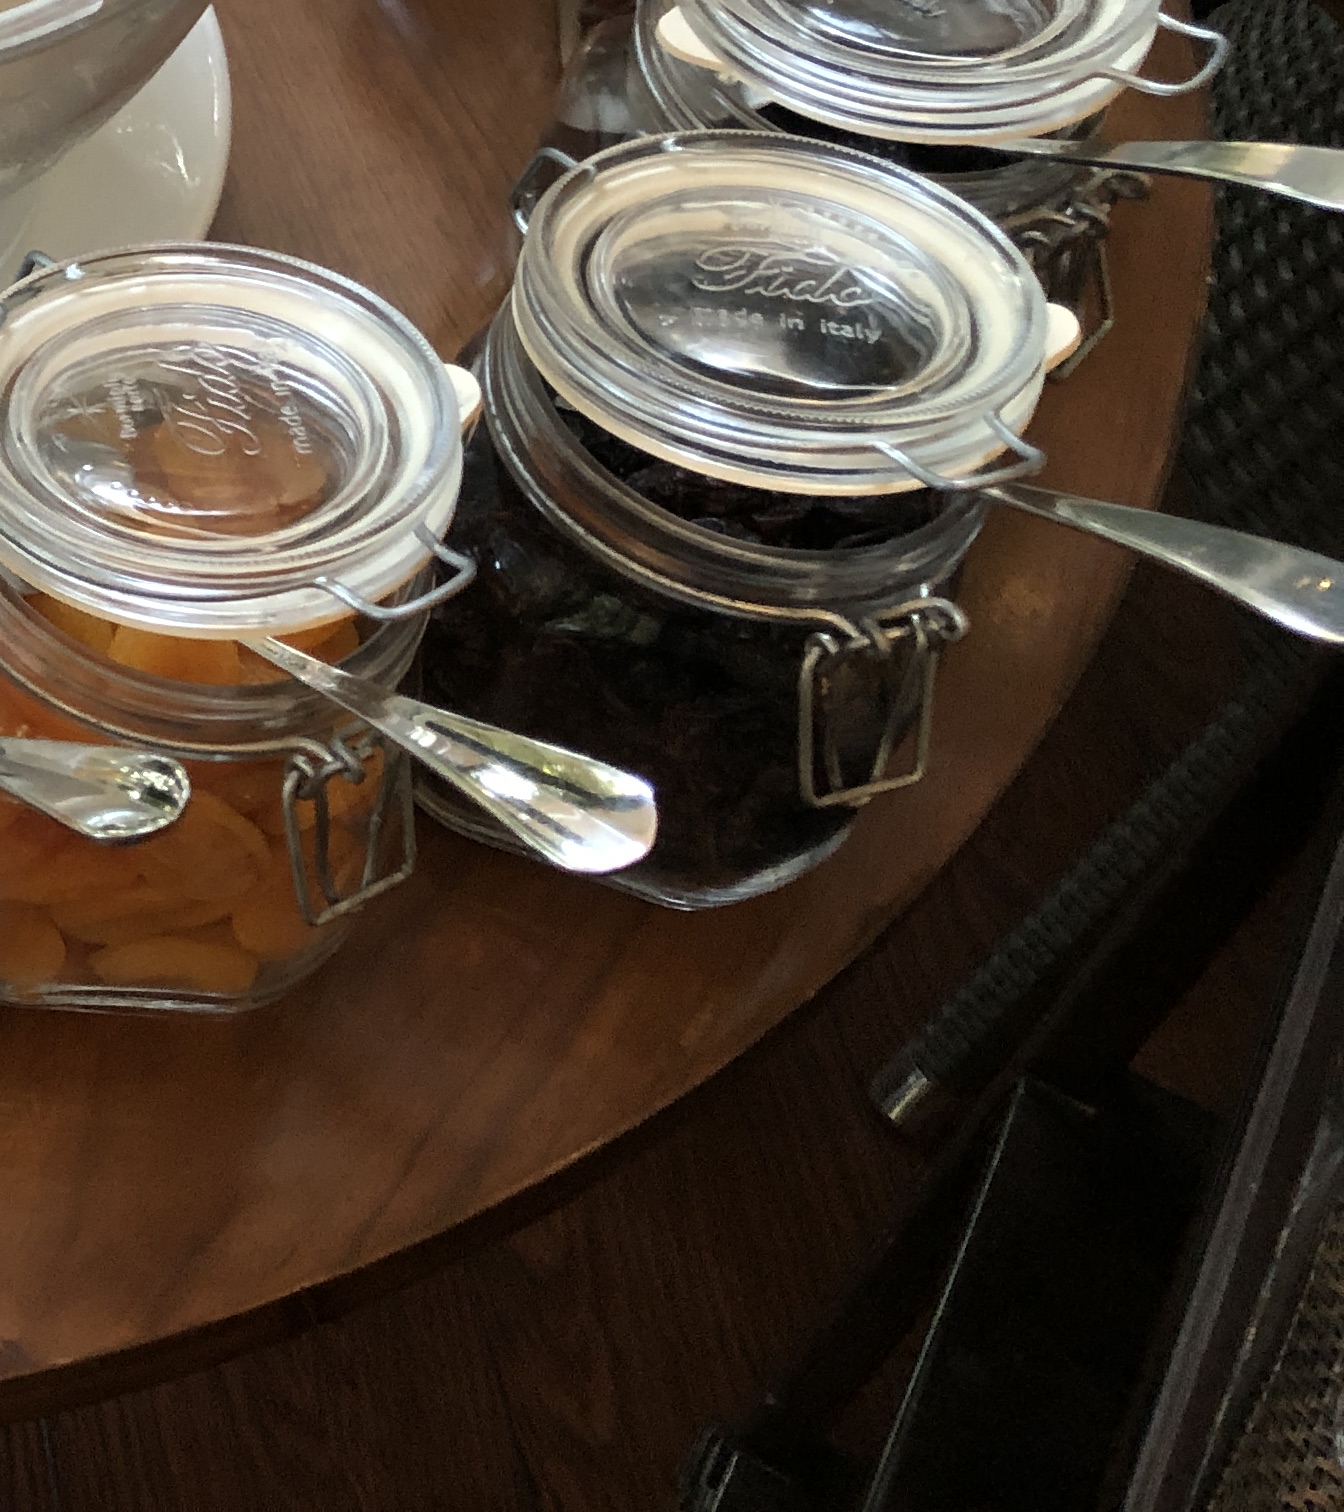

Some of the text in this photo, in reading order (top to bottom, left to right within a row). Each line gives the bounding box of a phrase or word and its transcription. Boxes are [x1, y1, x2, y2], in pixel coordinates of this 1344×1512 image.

[779, 312, 806, 331] in
[819, 317, 883, 345] italy
[278, 402, 314, 456] made
